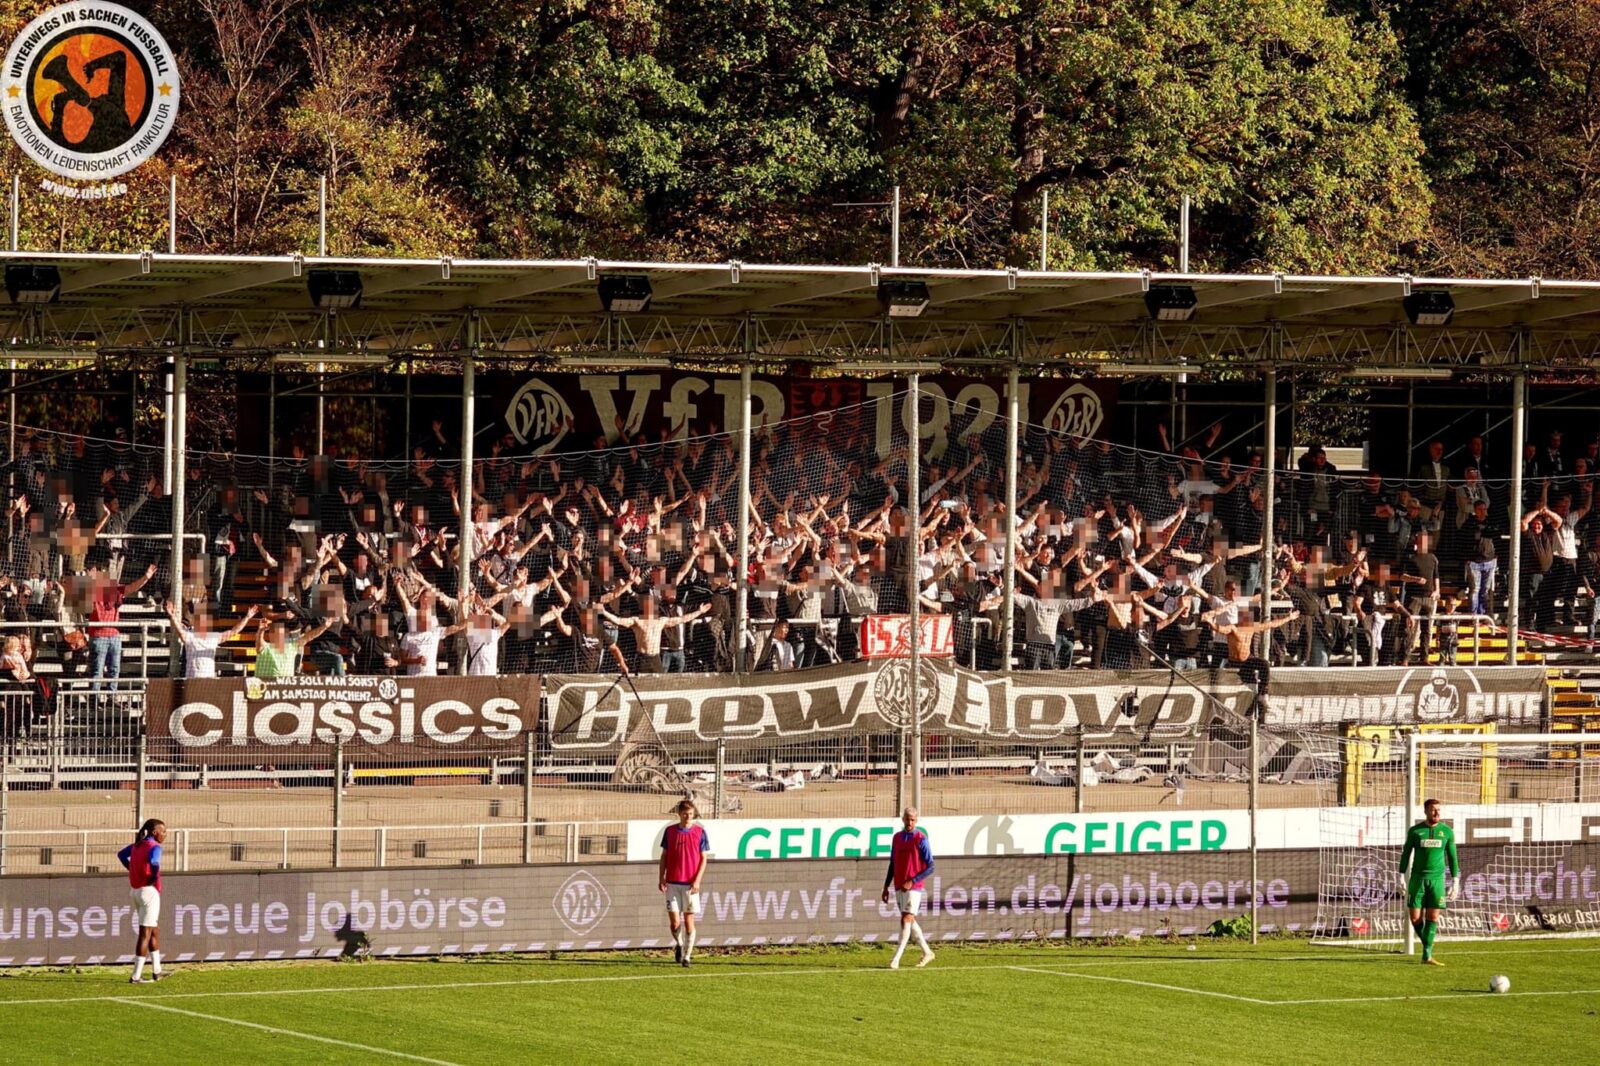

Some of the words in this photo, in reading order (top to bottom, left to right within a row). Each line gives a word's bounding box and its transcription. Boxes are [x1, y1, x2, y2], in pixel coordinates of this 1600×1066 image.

[866, 381, 1030, 464] 1921
[264, 690, 279, 700] AM
[282, 689, 326, 700] SAMSTAG
[300, 676, 324, 686] SOLL
[325, 676, 346, 686] MAN
[348, 677, 378, 687] SONST
[168, 687, 523, 747] classics
[1044, 819, 1228, 855] GEIGER
[174, 899, 289, 935] neue
